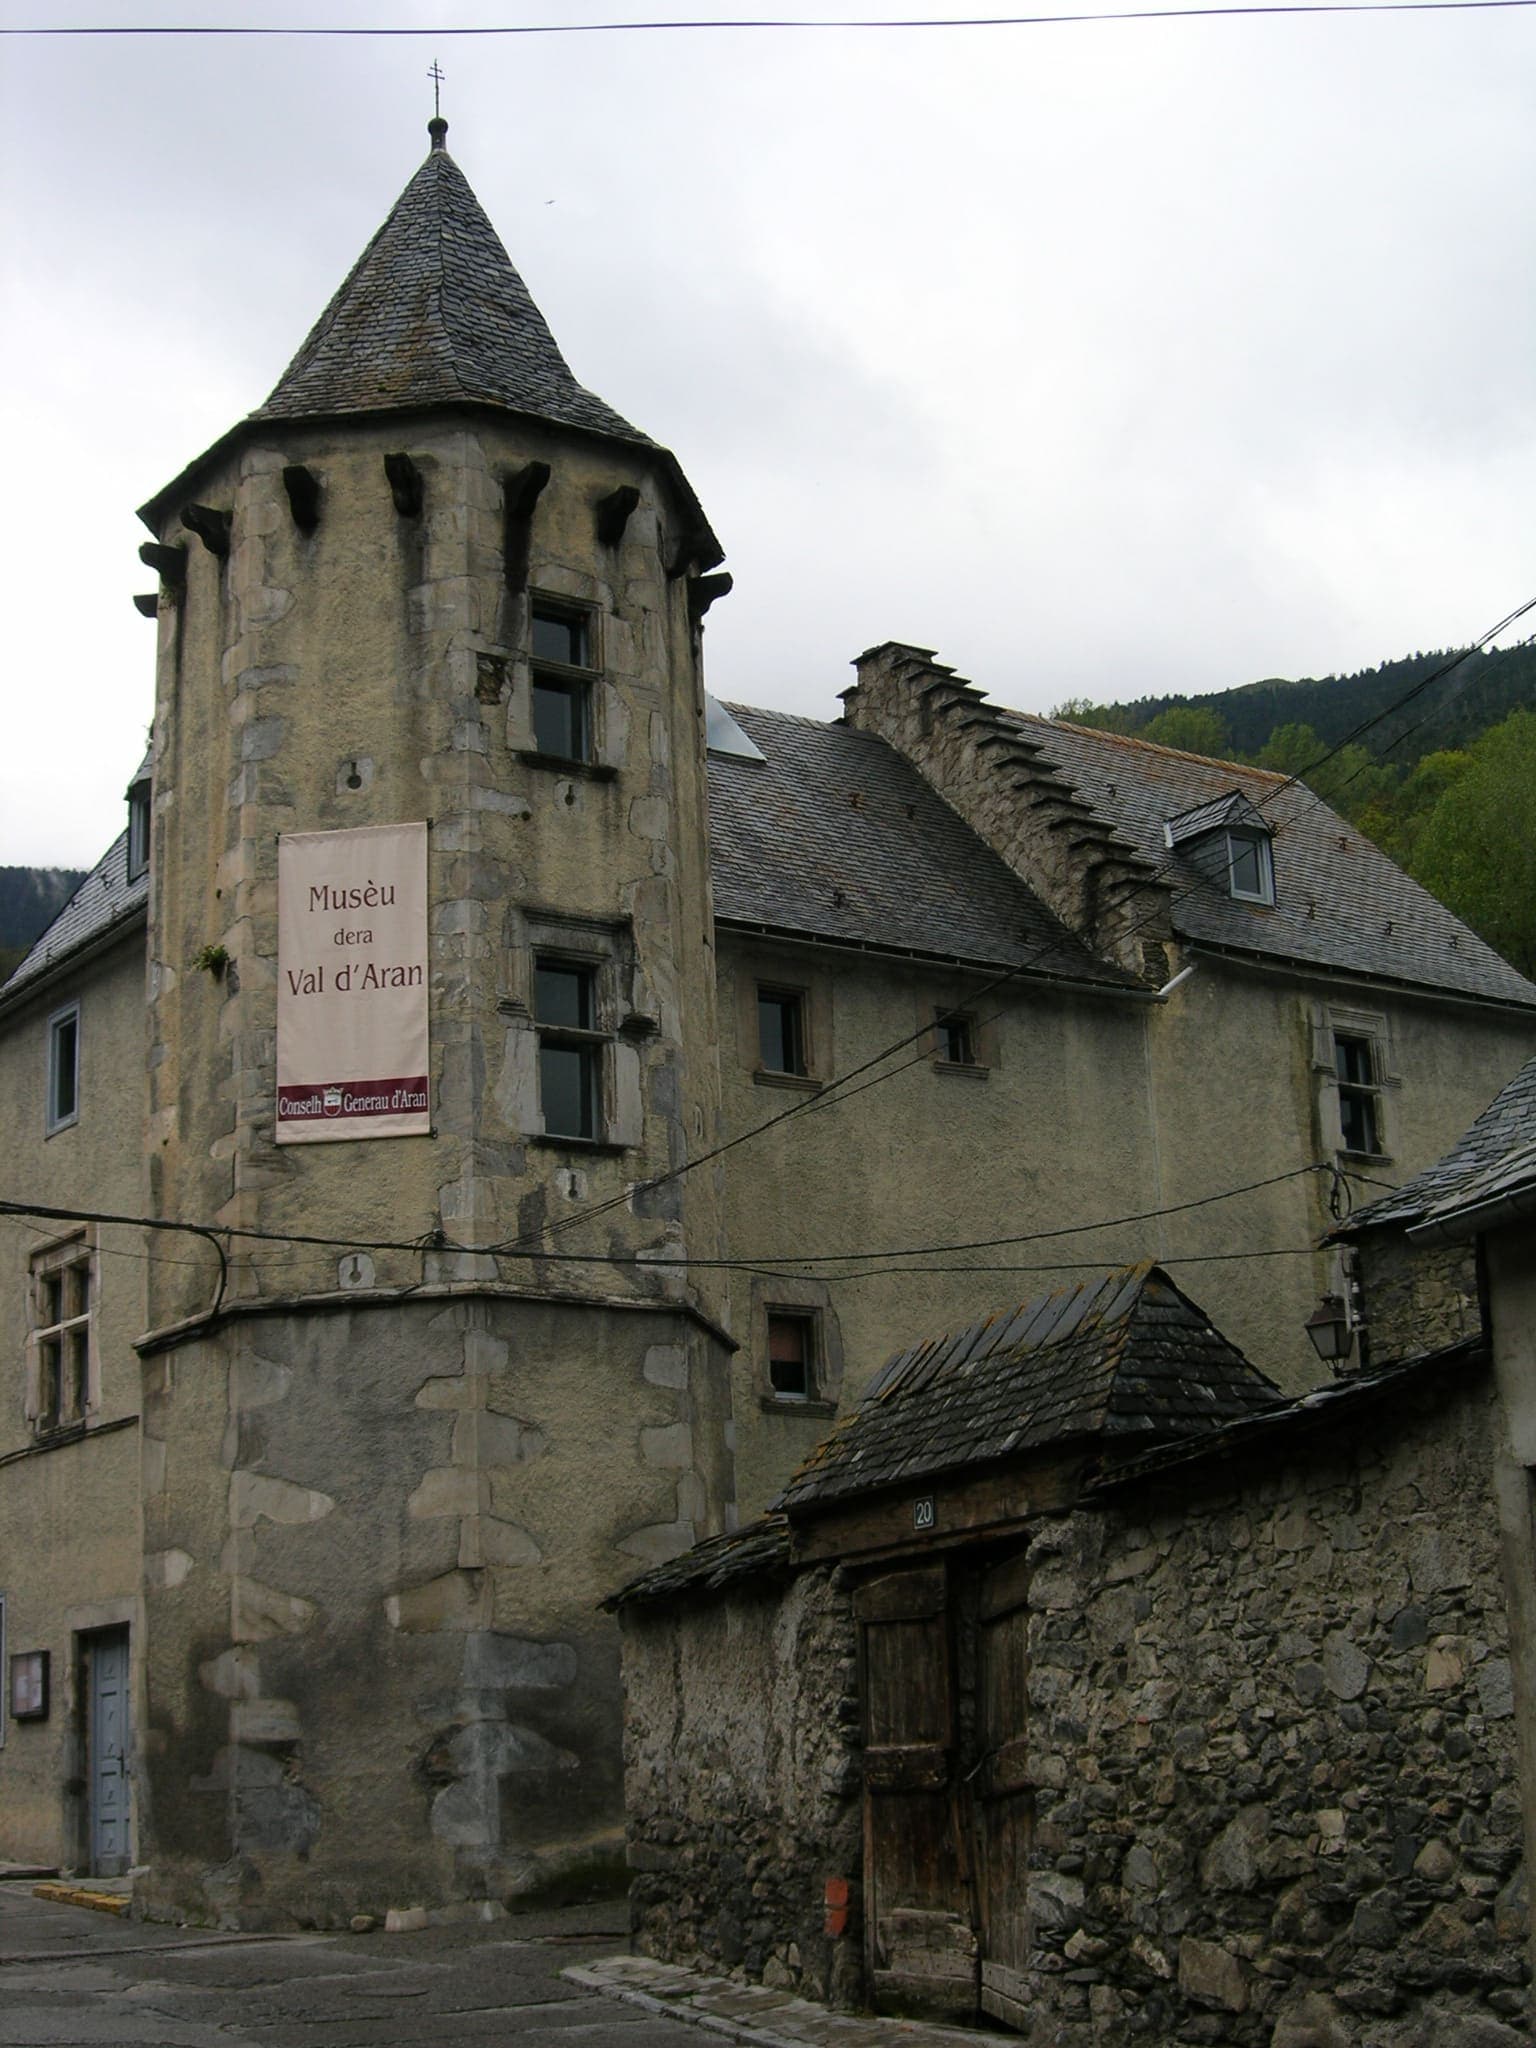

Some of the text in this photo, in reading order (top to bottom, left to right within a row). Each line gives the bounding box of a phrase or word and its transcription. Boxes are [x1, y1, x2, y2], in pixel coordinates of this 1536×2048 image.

[309, 880, 395, 912] Musèu
[334, 927, 373, 946] dera
[287, 963, 422, 995] Val d'Aran
[279, 1089, 427, 1116] Conselh Generau d'Aran
[916, 1501, 932, 1524] 20
